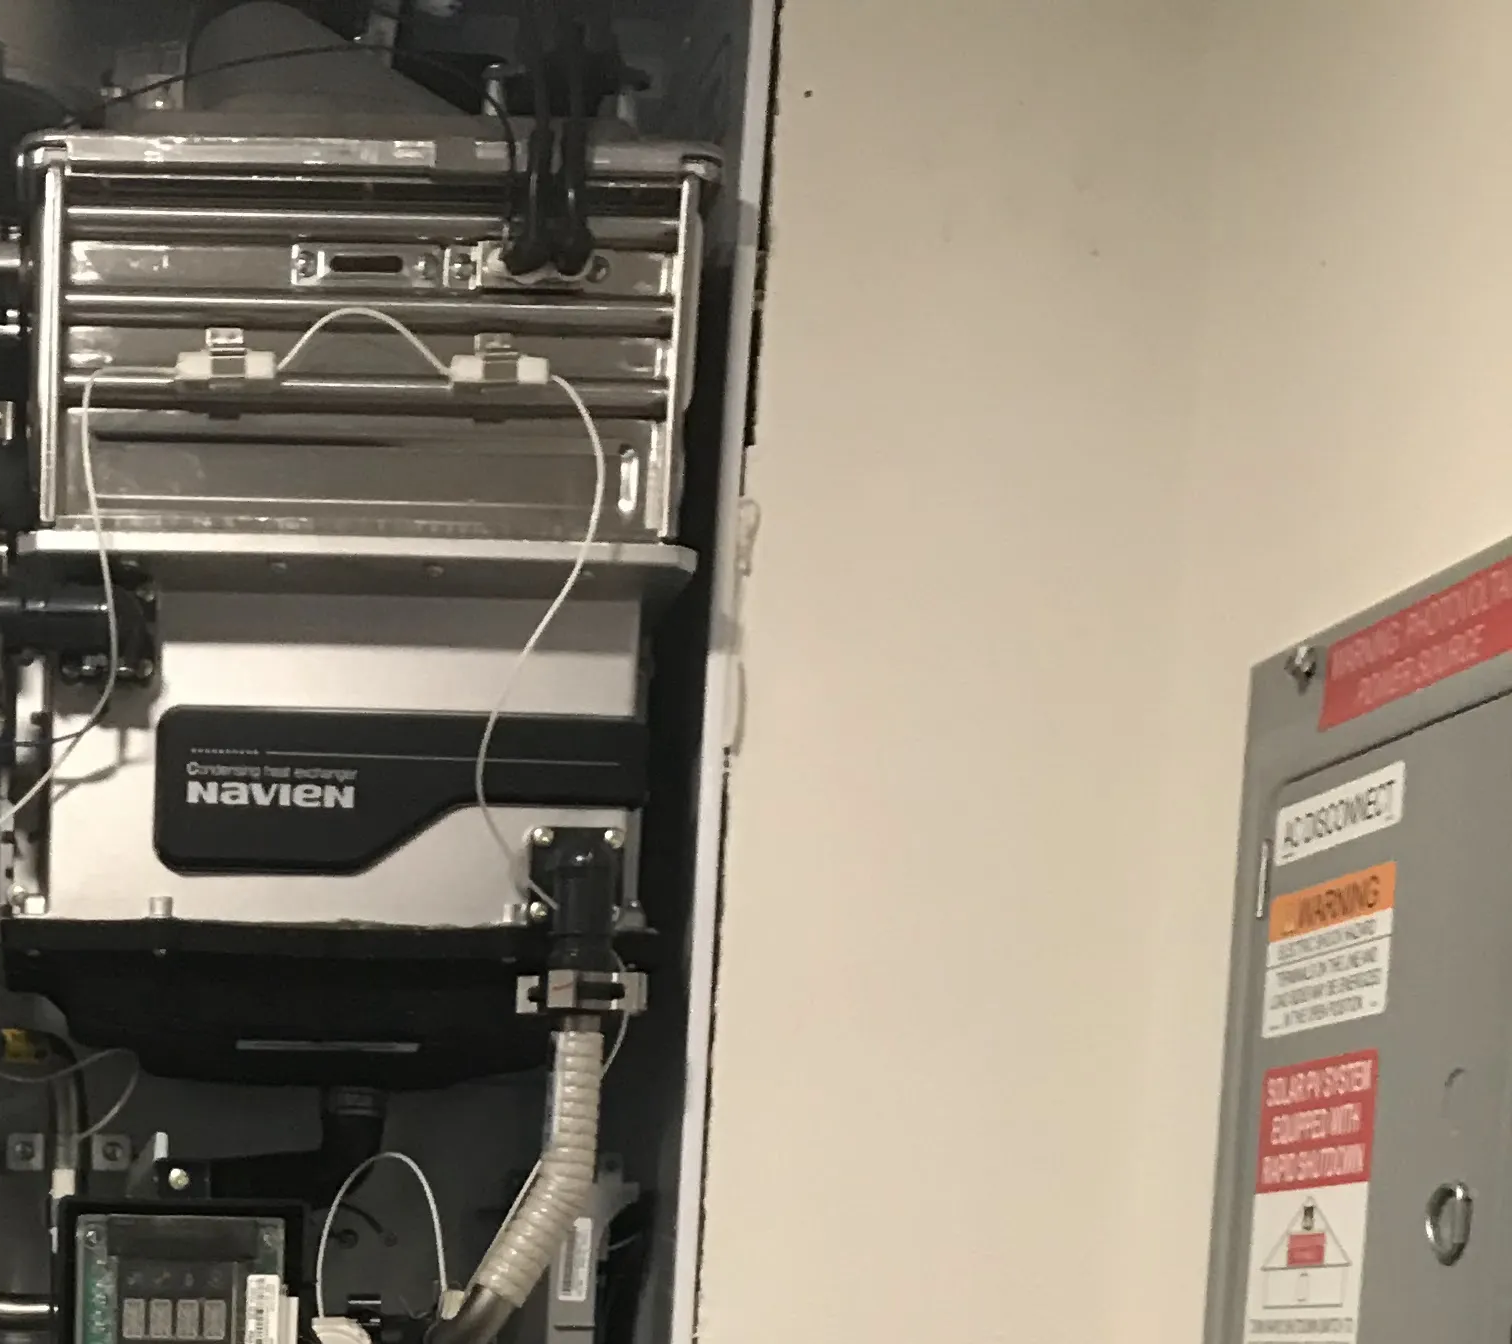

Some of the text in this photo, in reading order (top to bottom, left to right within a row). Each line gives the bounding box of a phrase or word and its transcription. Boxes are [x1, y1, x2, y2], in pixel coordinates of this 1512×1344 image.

[1303, 779, 1395, 843] DISCONNECT
[1298, 875, 1380, 929] WARNING
[1324, 1060, 1372, 1097] SYSTEM
